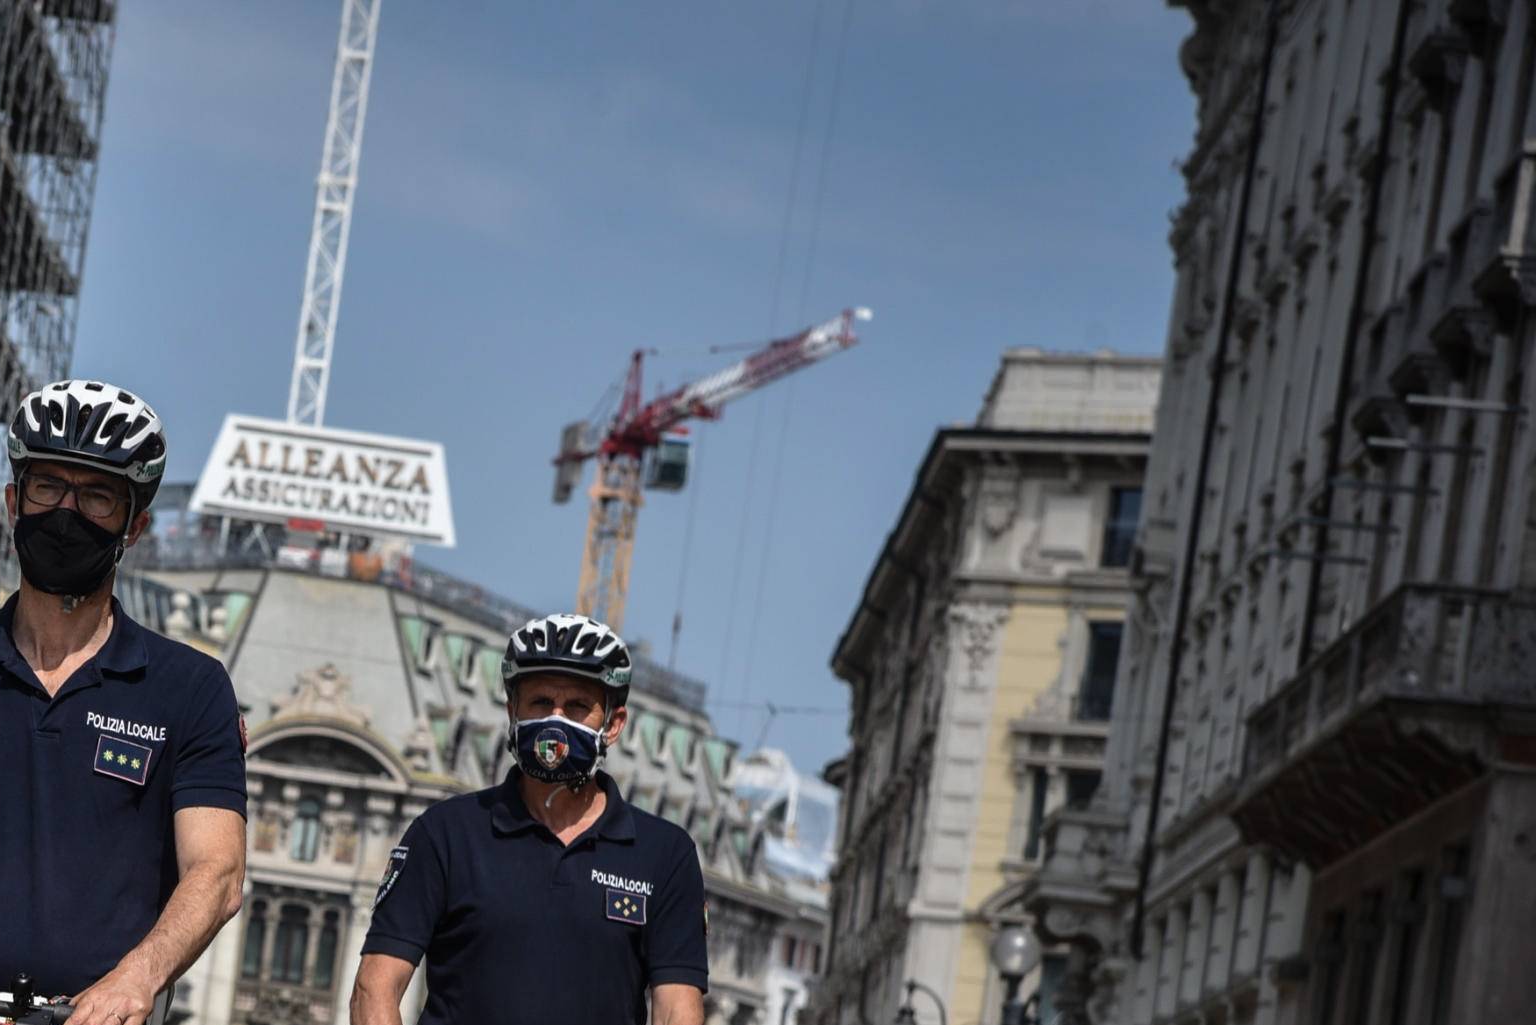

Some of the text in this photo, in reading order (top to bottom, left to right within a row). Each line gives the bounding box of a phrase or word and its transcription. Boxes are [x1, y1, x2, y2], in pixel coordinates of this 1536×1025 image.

[227, 437, 431, 495] ALLEANZA
[221, 476, 430, 526] ASSICURAZIONI
[86, 711, 167, 741] POLIZIA LOCALE
[591, 868, 654, 896] POLIZIA LOCAL
